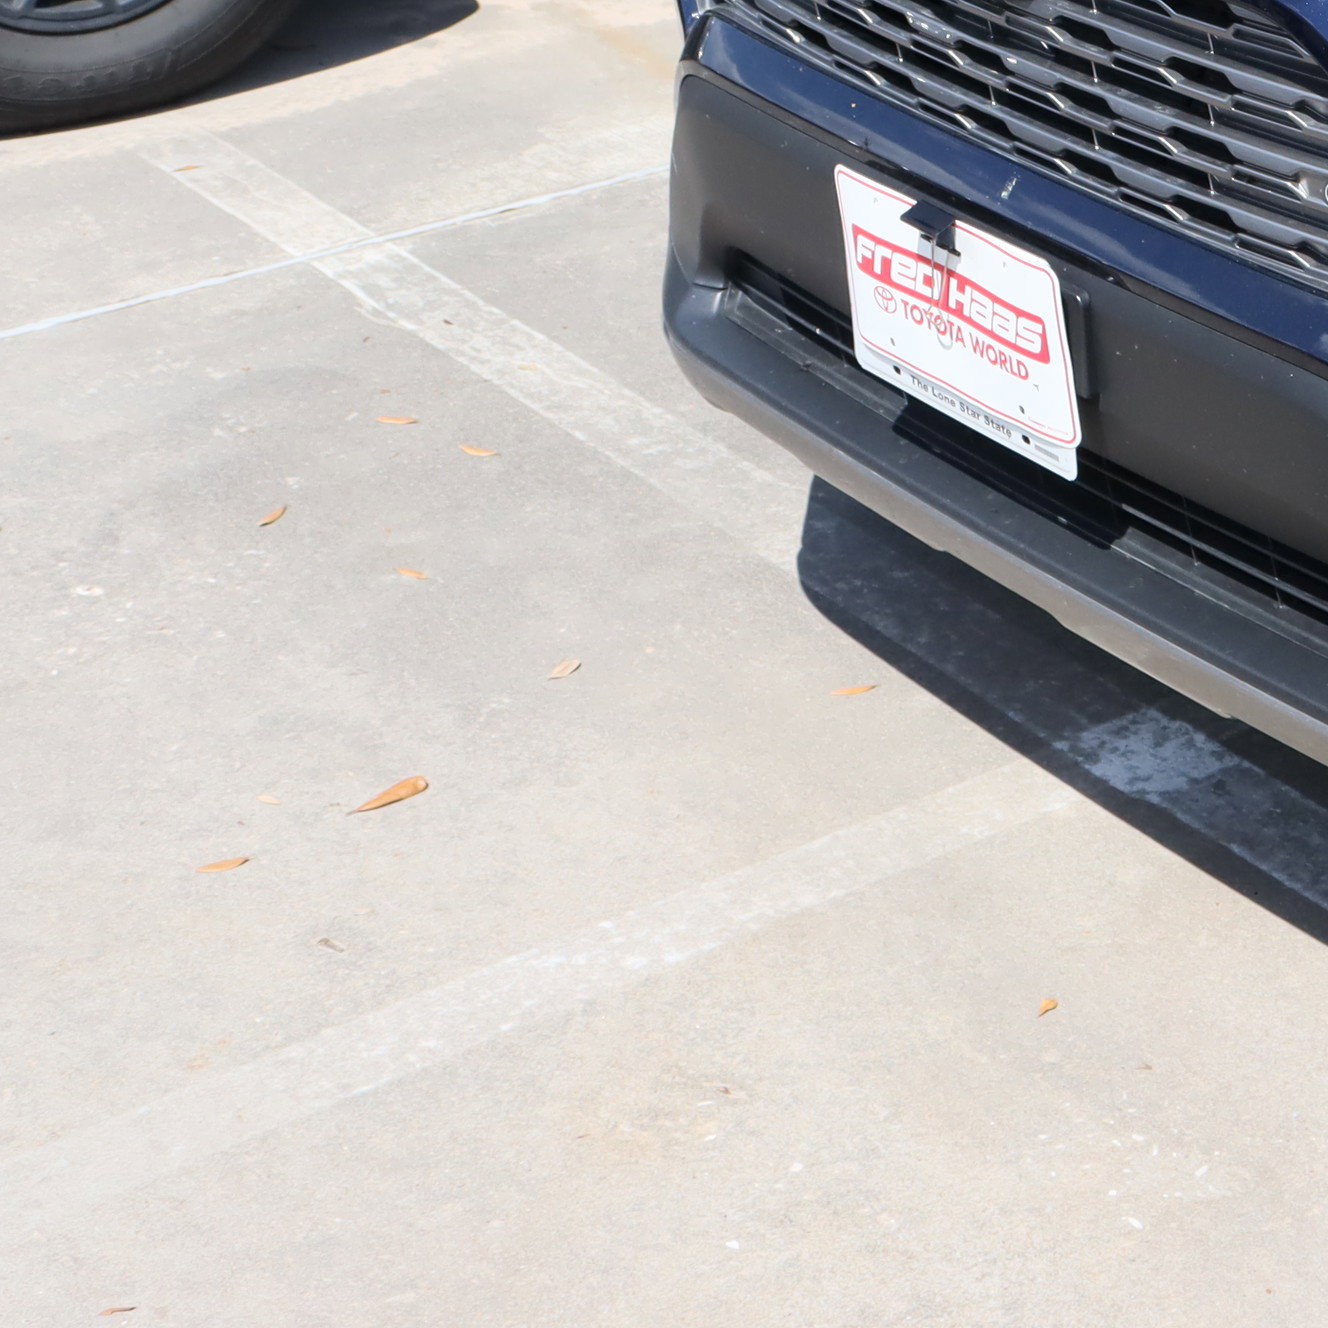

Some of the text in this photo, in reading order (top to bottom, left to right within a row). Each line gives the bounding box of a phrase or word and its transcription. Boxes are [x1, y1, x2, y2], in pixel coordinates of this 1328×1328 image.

[900, 298, 1029, 381] TOYOTA WORLD
[947, 276, 1044, 354] Haas
[910, 374, 929, 392] The
[931, 385, 957, 408] Lone
[959, 401, 982, 421] Star
[983, 414, 1012, 439] State
